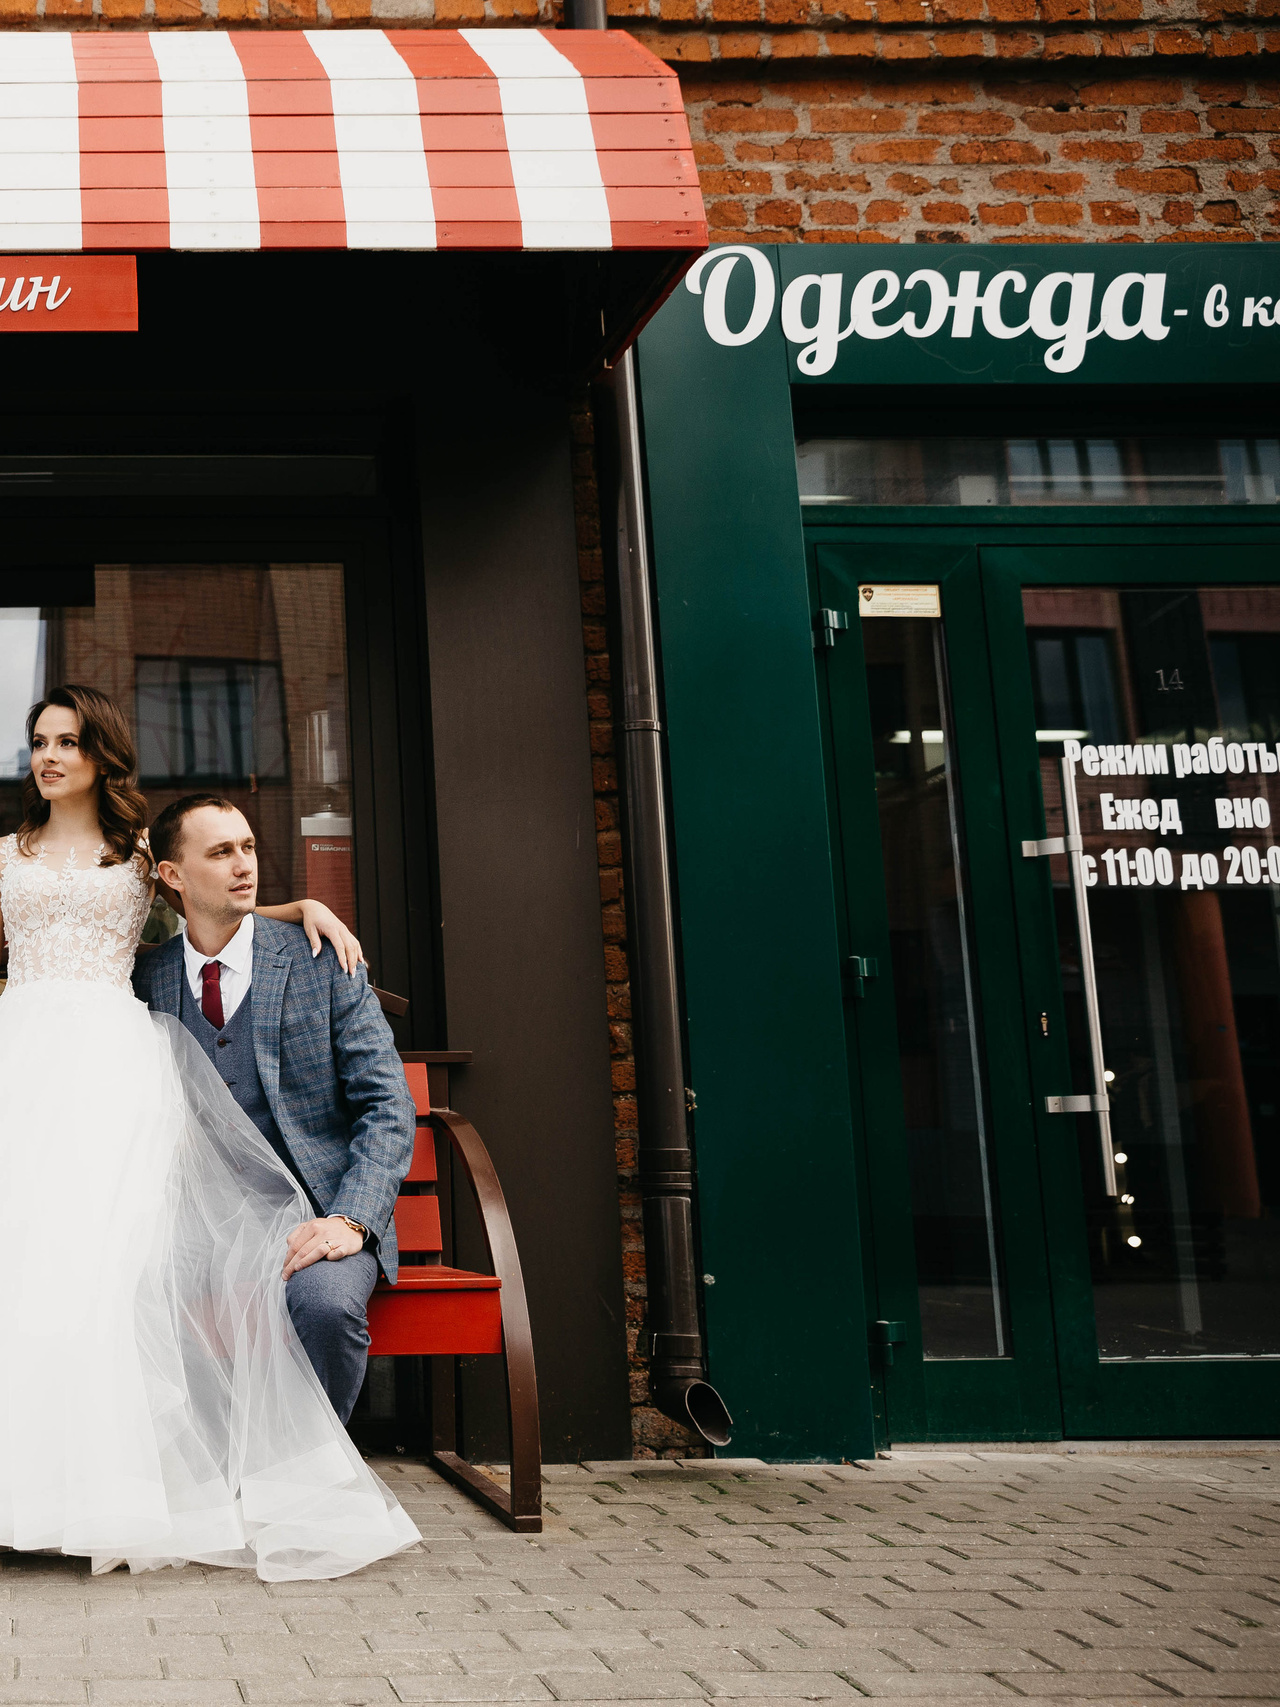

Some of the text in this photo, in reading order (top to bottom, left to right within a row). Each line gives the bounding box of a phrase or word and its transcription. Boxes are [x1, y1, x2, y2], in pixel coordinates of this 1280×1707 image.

[684, 245, 1171, 377] Одежда
[1203, 283, 1229, 328] в
[1154, 668, 1185, 691] 14
[1063, 739, 1170, 777] Режим
[1081, 854, 1099, 888] с
[1100, 847, 1175, 887] 11:00
[1179, 853, 1220, 891] до
